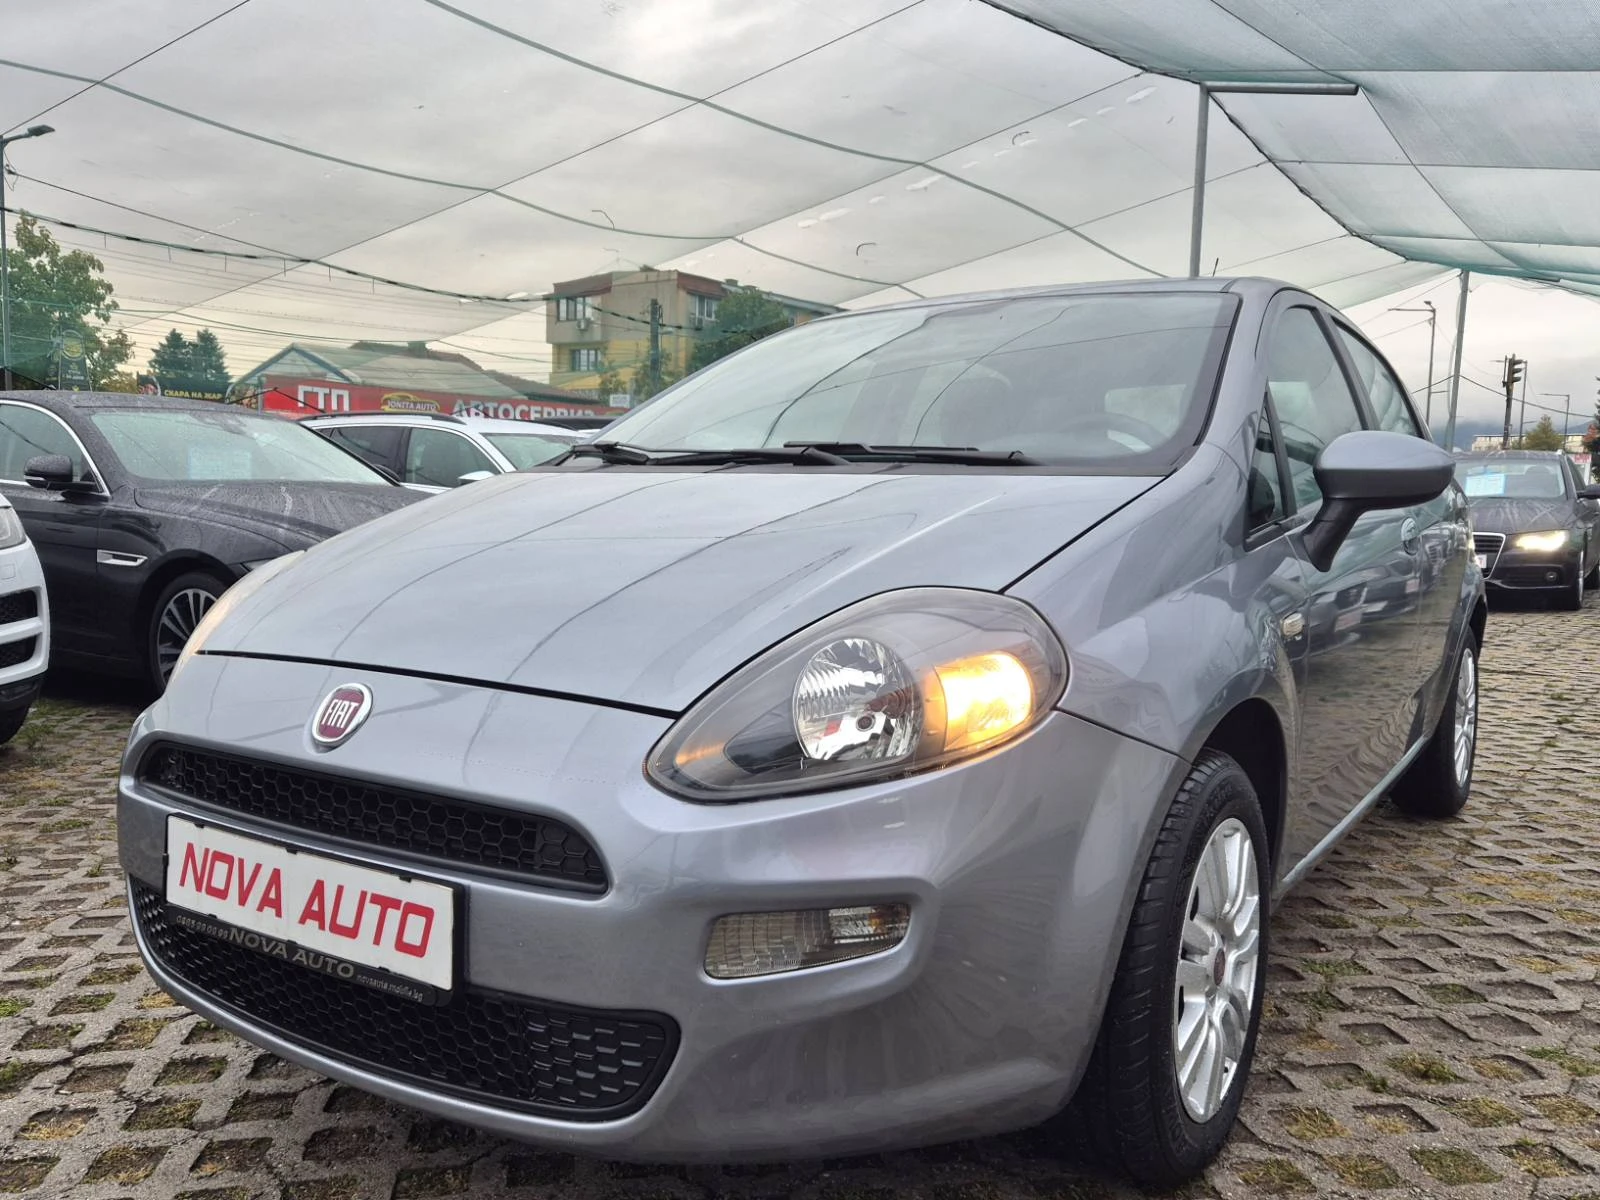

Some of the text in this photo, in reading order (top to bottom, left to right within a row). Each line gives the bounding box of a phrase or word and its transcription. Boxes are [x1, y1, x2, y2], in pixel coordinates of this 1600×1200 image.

[164, 389, 190, 398] СКАРА
[191, 391, 203, 399] НА
[297, 385, 350, 412] ГТП
[416, 402, 437, 411] AUTO
[321, 698, 359, 729] FIAT
[179, 842, 435, 958] NOVA AUTO
[229, 927, 288, 959] NOVA
[292, 948, 354, 978] AUTO
